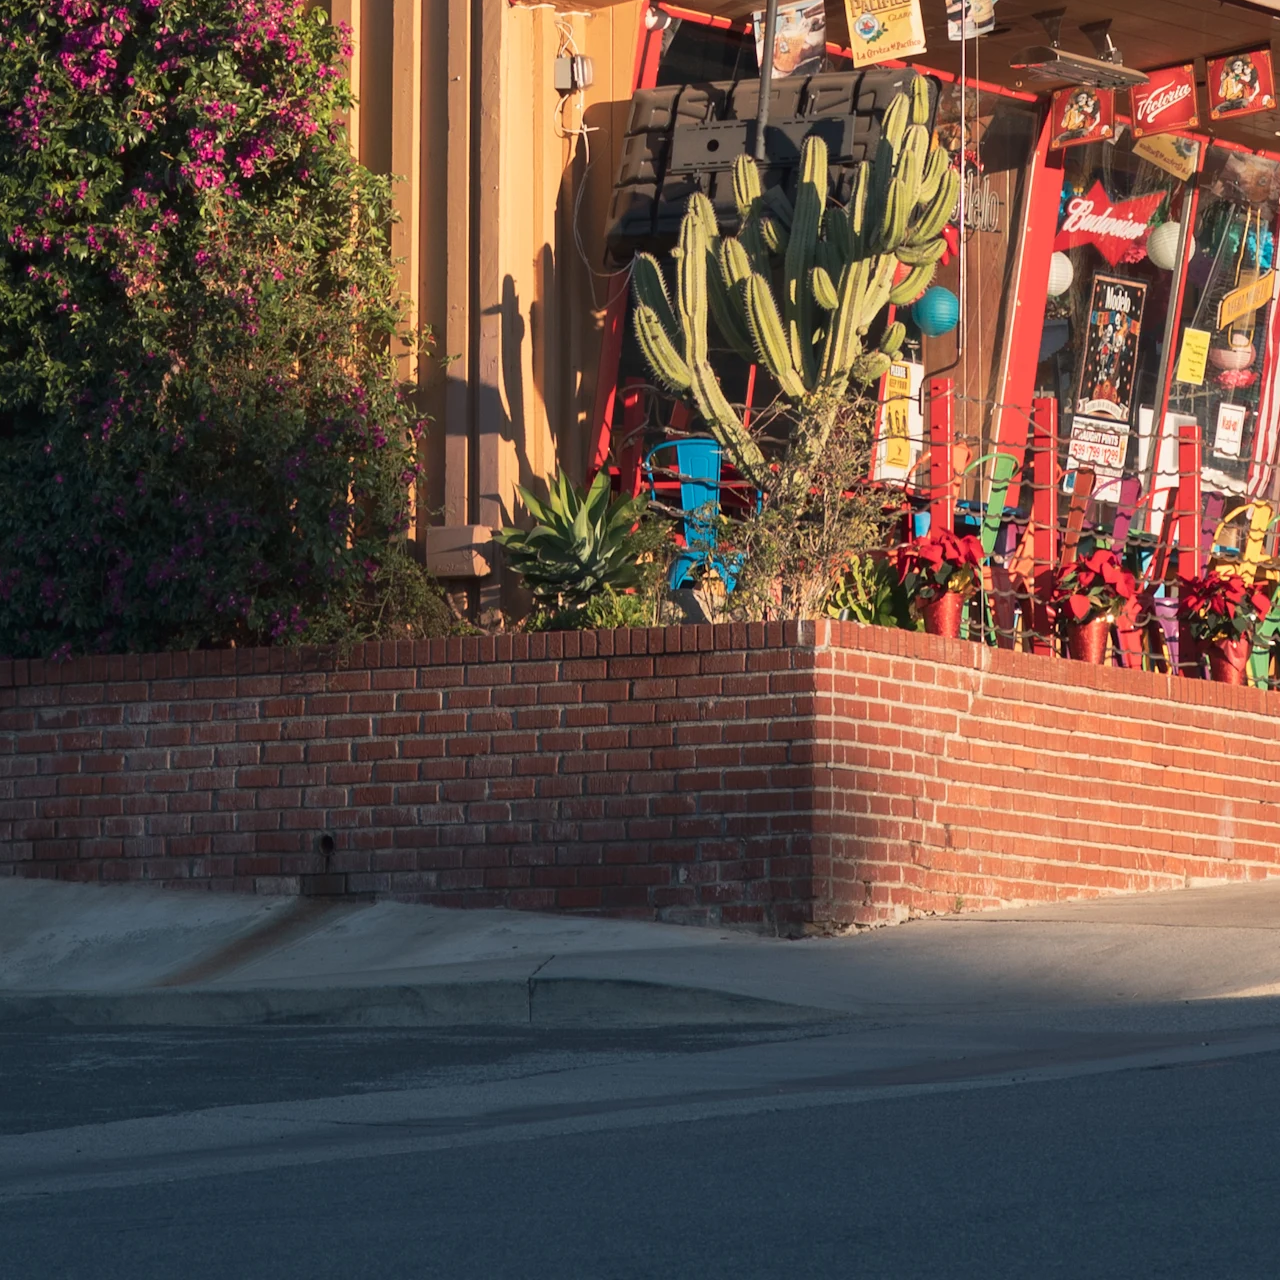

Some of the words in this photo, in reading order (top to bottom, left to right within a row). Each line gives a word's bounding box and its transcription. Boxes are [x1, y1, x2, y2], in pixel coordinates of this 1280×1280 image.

[1136, 80, 1192, 123] Victoria
[1063, 198, 1148, 240] Budweiser
[1105, 286, 1131, 313] Modelo
